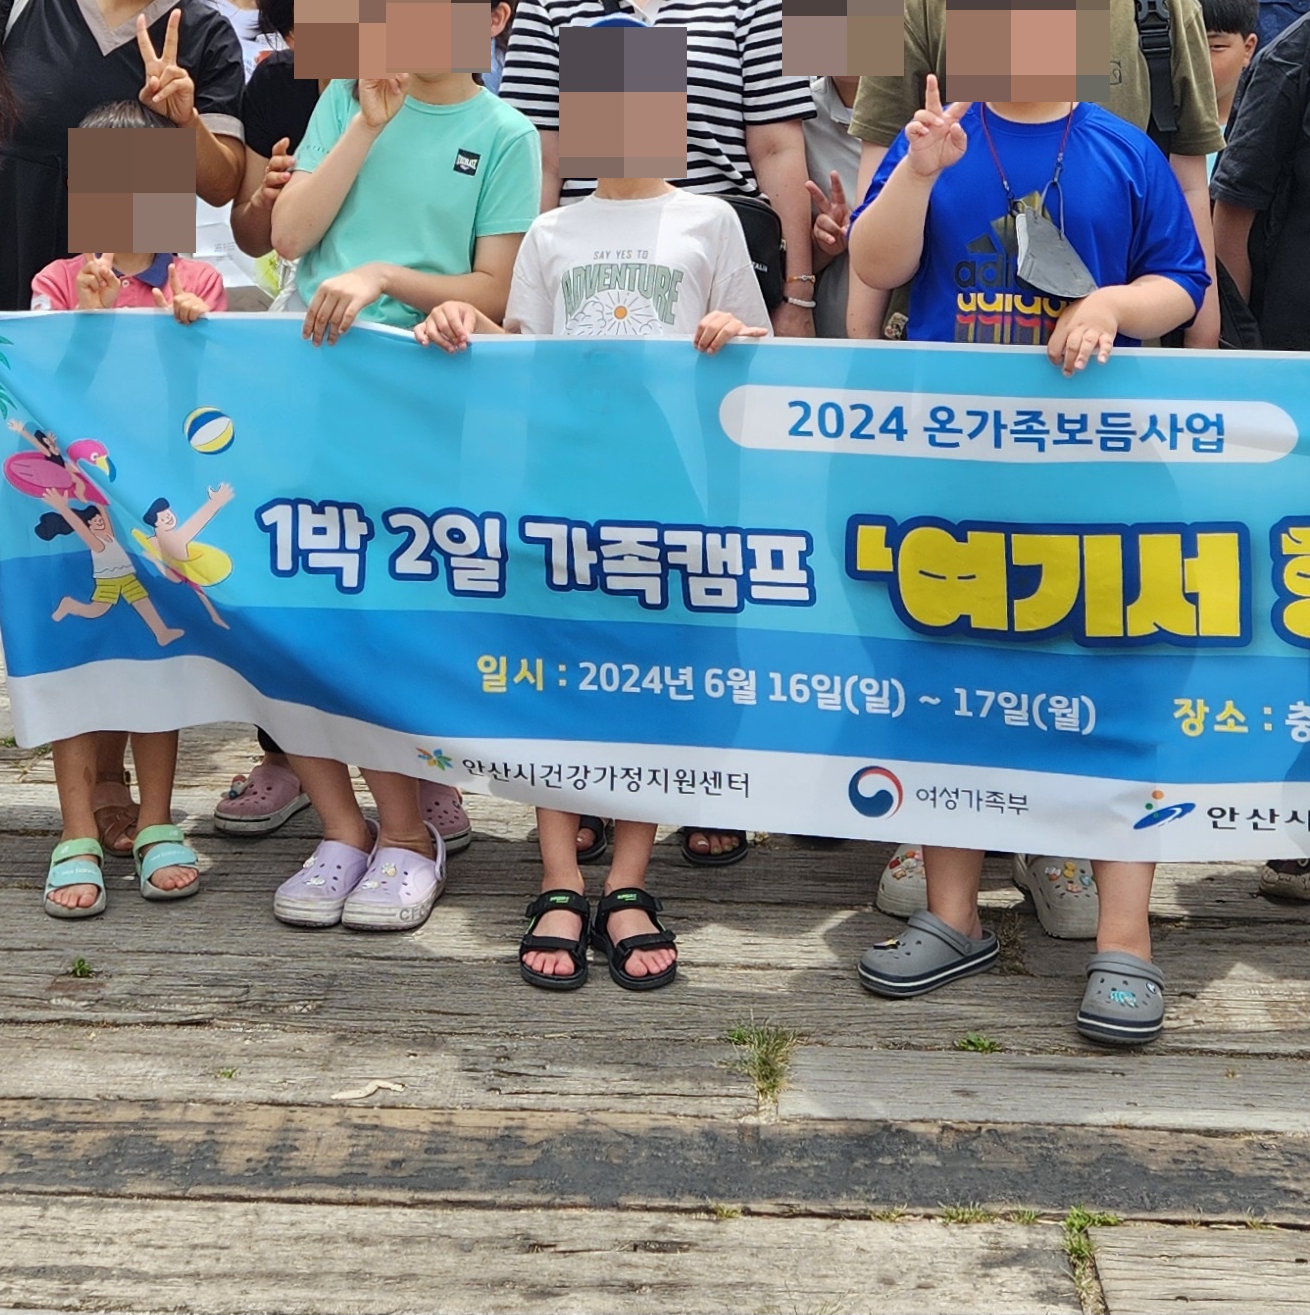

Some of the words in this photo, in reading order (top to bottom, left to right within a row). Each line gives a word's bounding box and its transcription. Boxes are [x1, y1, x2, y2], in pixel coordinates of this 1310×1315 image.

[593, 249, 610, 261] SAY
[616, 249, 632, 260] YES
[637, 249, 649, 260] TO
[561, 262, 684, 326] ADVENTURE
[787, 400, 908, 442] 2024
[923, 405, 1226, 454] 온가족보듬사업
[258, 502, 371, 590] 1박
[386, 510, 503, 595] 2일
[522, 519, 813, 610] 가족캠프
[477, 654, 543, 693] 일시
[558, 663, 567, 687] :
[579, 661, 695, 701] 2024년
[704, 667, 757, 706] 6월
[768, 671, 906, 718] 16일(일)
[918, 696, 941, 706] ~
[953, 687, 1097, 736] 17일(월)
[1173, 698, 1249, 737] 장소
[1263, 706, 1272, 732] :
[462, 758, 750, 799] 안산시건강가정지원센터
[916, 786, 1030, 816] 여성가족부
